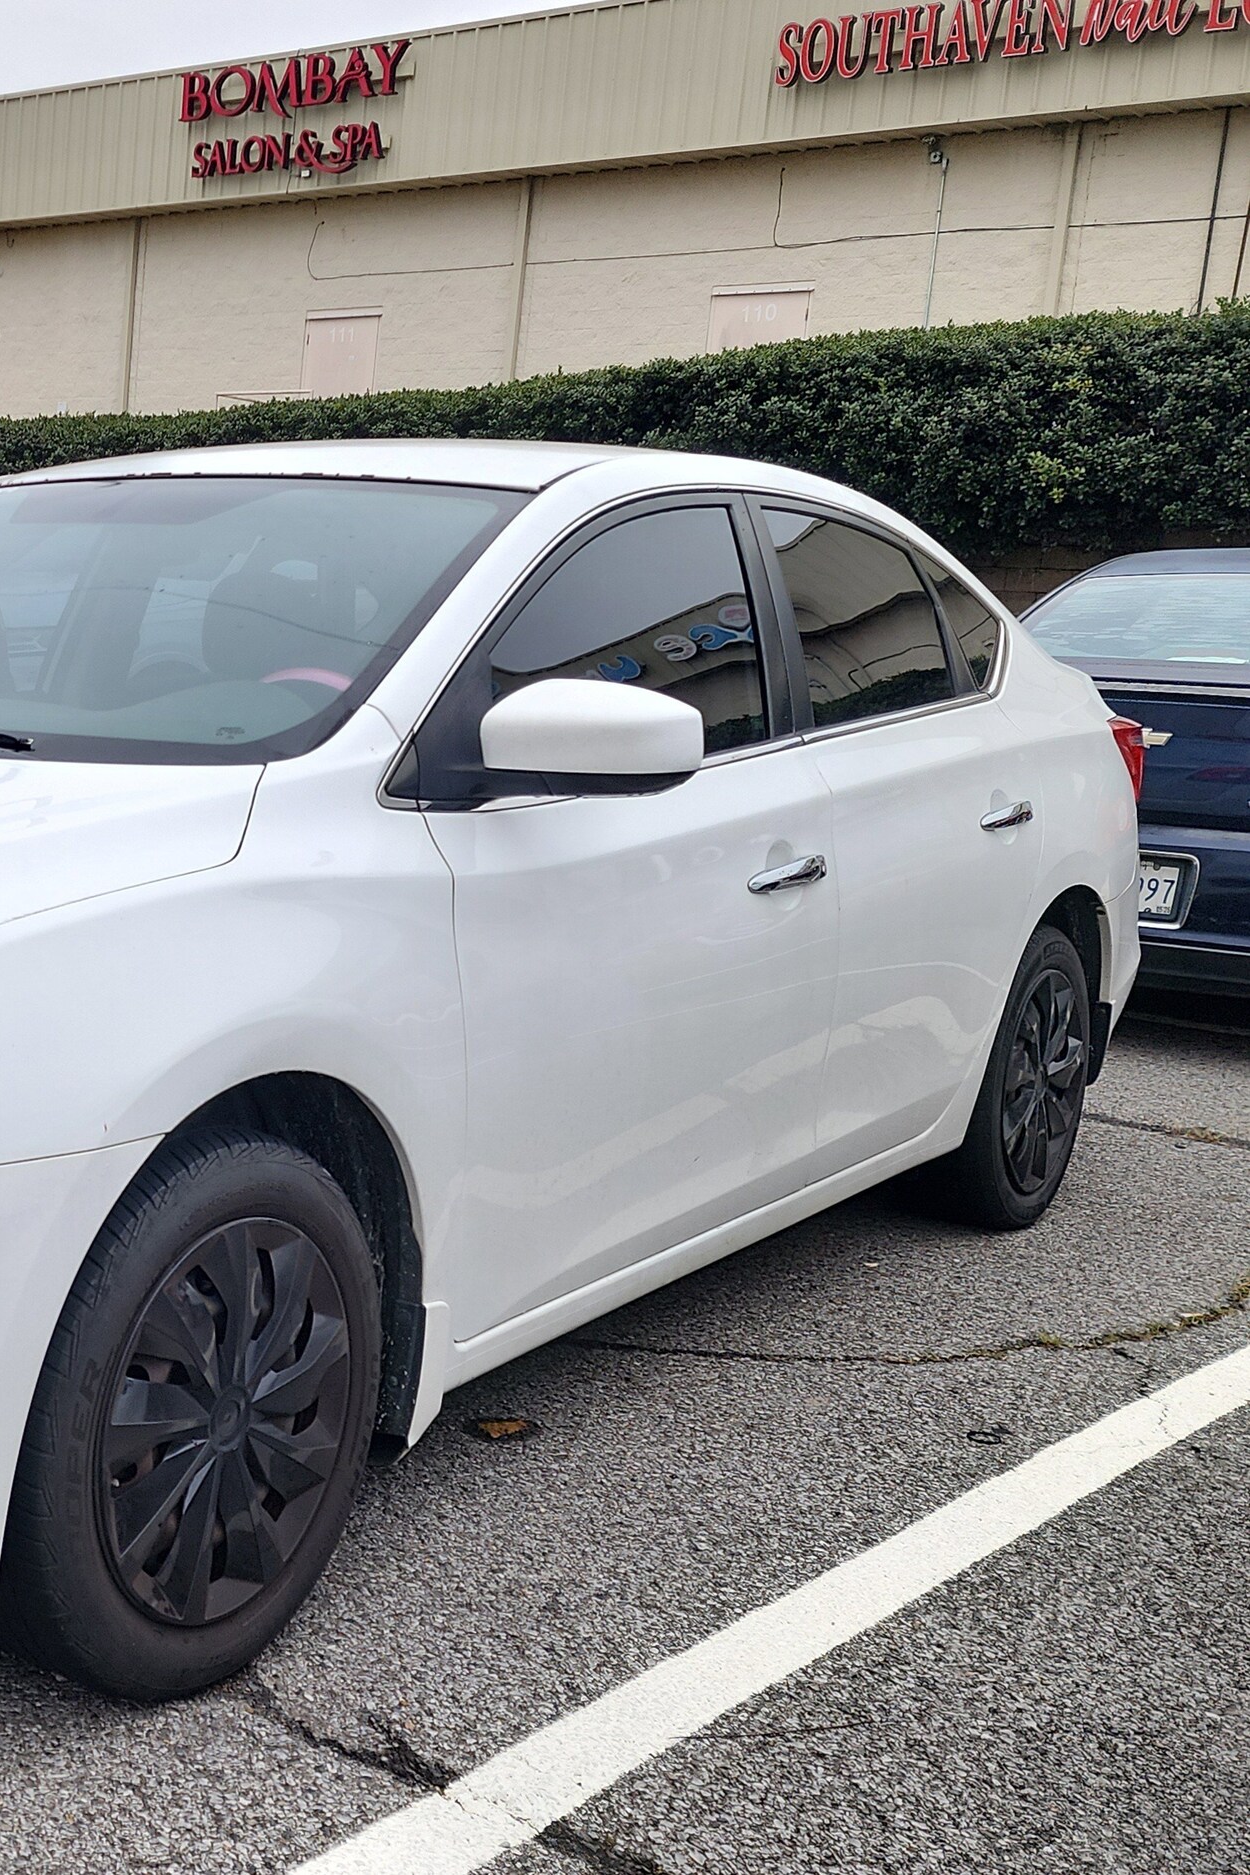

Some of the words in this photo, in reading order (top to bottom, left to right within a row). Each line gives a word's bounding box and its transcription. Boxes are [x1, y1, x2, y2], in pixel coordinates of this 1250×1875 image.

[774, 0, 1072, 88] SOUTHAVEN
[178, 39, 412, 122] BOMBAY
[191, 132, 294, 178] SALON
[294, 128, 358, 174] &
[329, 120, 386, 164] SPA
[329, 327, 354, 342] 111
[742, 304, 777, 323] 110
